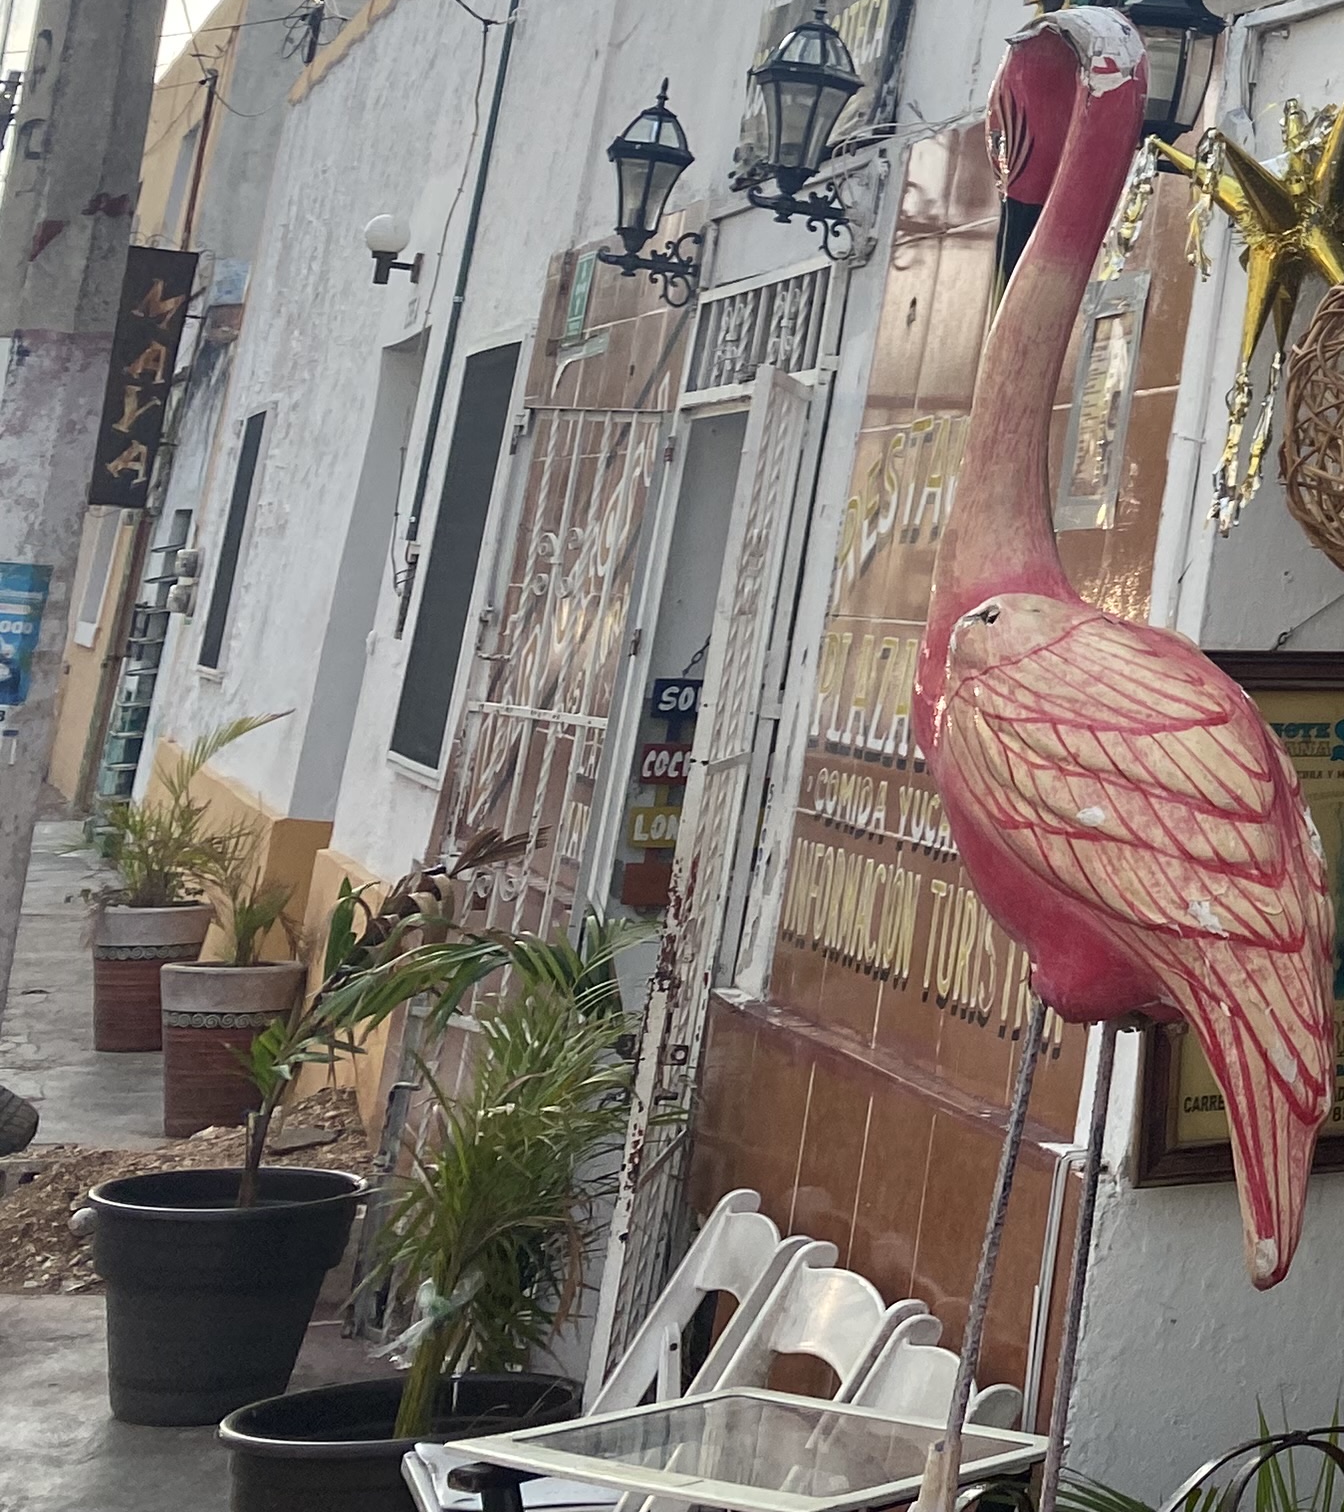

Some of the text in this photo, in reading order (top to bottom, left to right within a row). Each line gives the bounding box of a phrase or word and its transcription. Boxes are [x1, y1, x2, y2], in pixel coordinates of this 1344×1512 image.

[105, 278, 187, 485] MAYA
[814, 767, 888, 836] COMIDA
[898, 785, 957, 851] YUCA
[1183, 1094, 1226, 1114] CARRE
